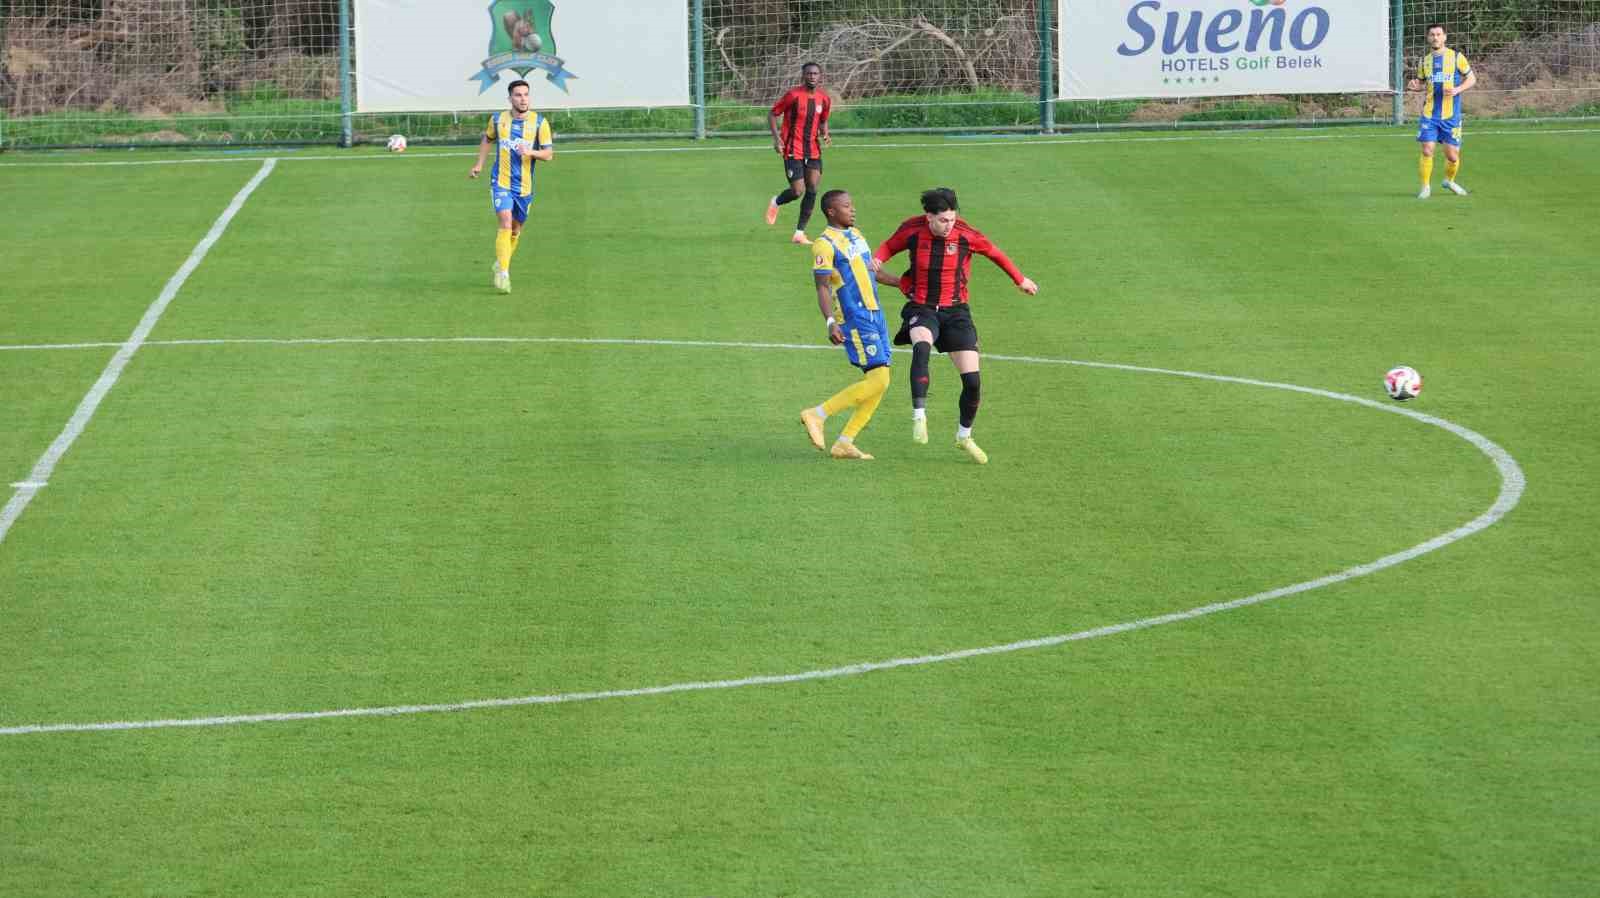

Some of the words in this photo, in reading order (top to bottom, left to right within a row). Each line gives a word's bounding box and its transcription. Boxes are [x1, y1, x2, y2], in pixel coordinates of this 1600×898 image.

[1161, 58, 1229, 72] HOTELS
[1236, 56, 1271, 70] Golf
[1276, 55, 1323, 69] Belek
